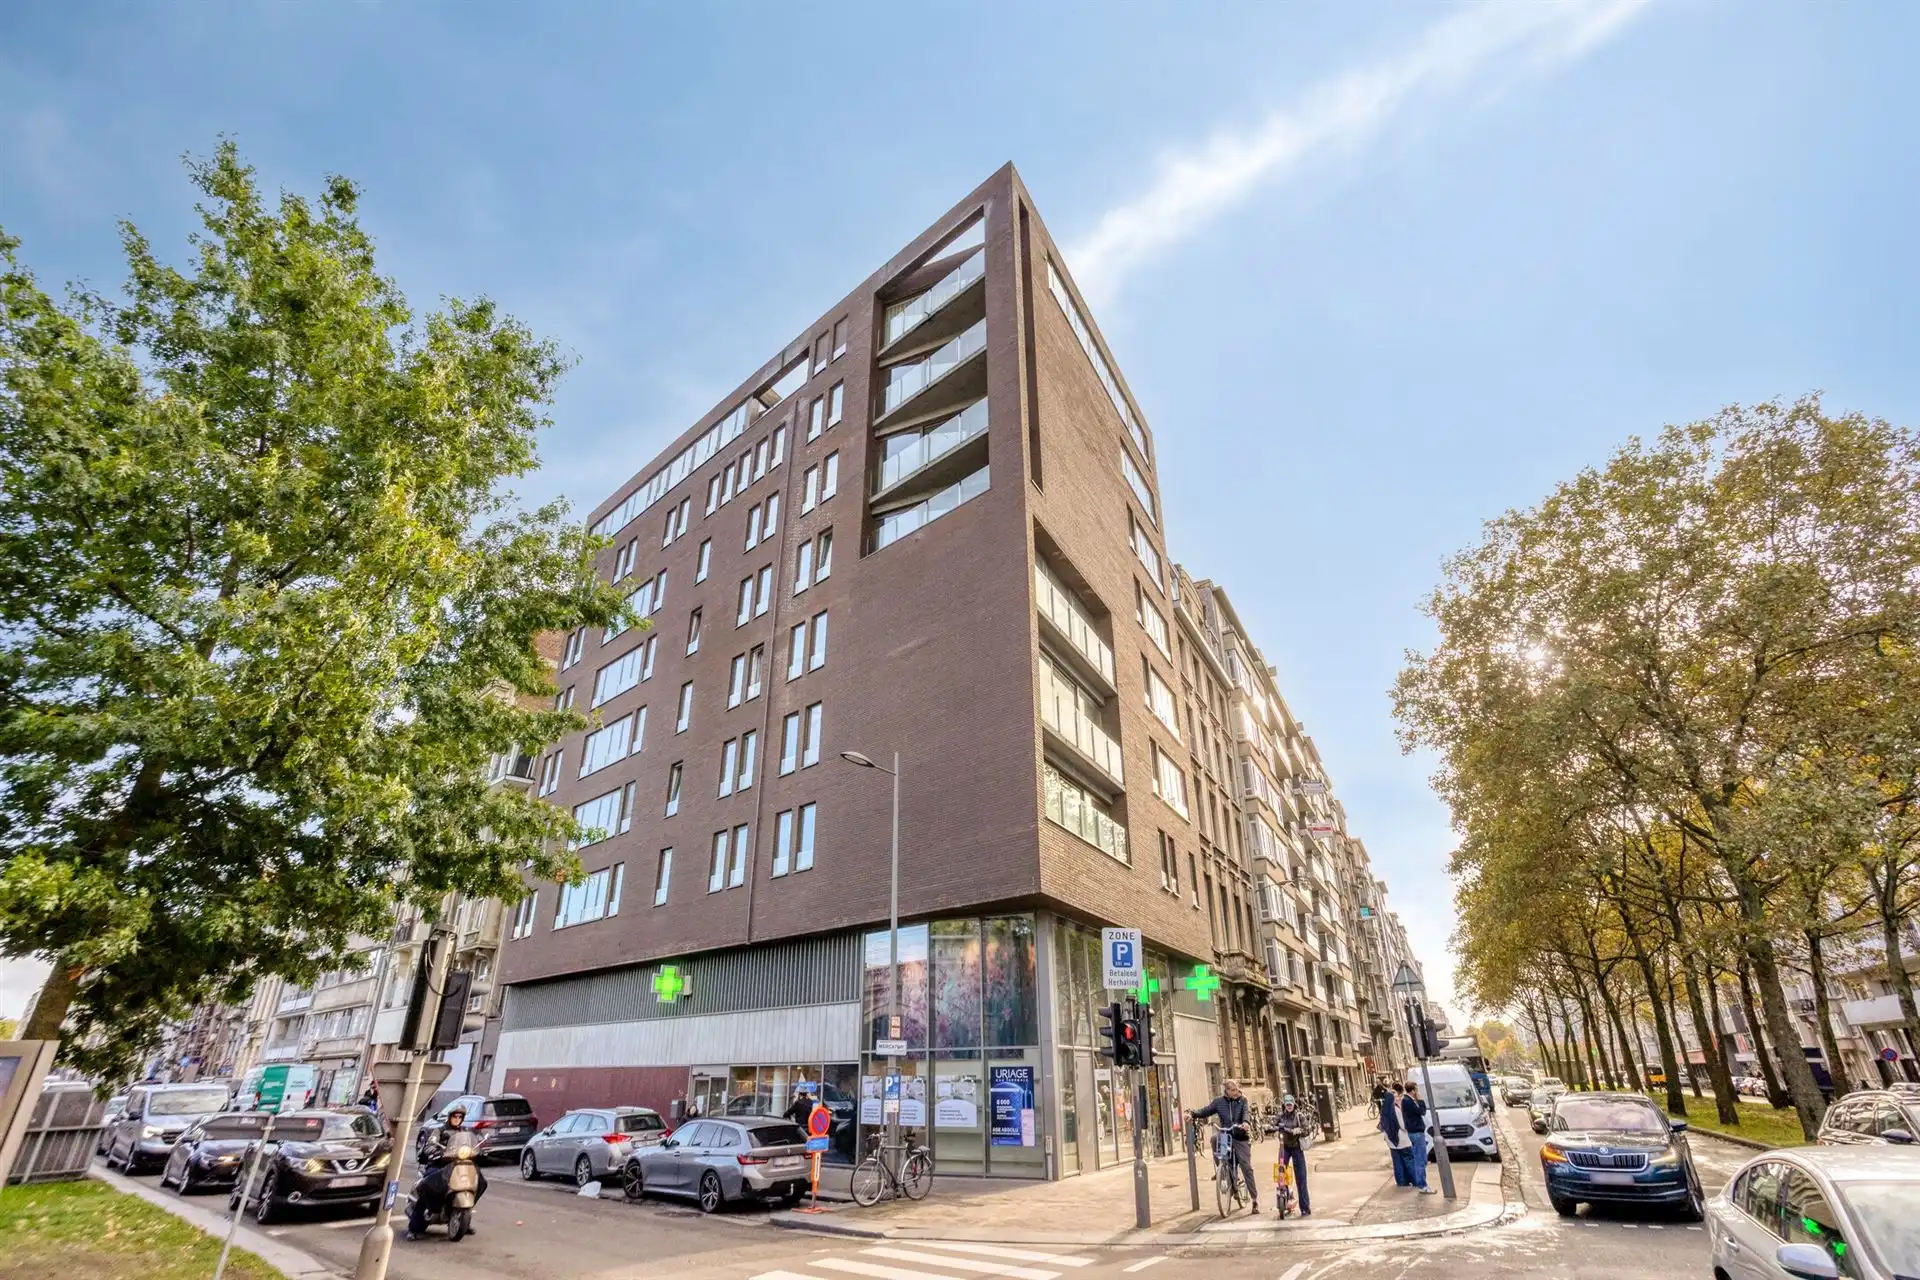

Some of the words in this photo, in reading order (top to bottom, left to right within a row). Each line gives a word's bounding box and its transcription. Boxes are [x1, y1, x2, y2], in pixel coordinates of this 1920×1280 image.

[1108, 932, 1135, 940] ZONE
[1117, 944, 1128, 960] P
[995, 1069, 1028, 1079] URIAGE
[885, 1076, 893, 1091] P
